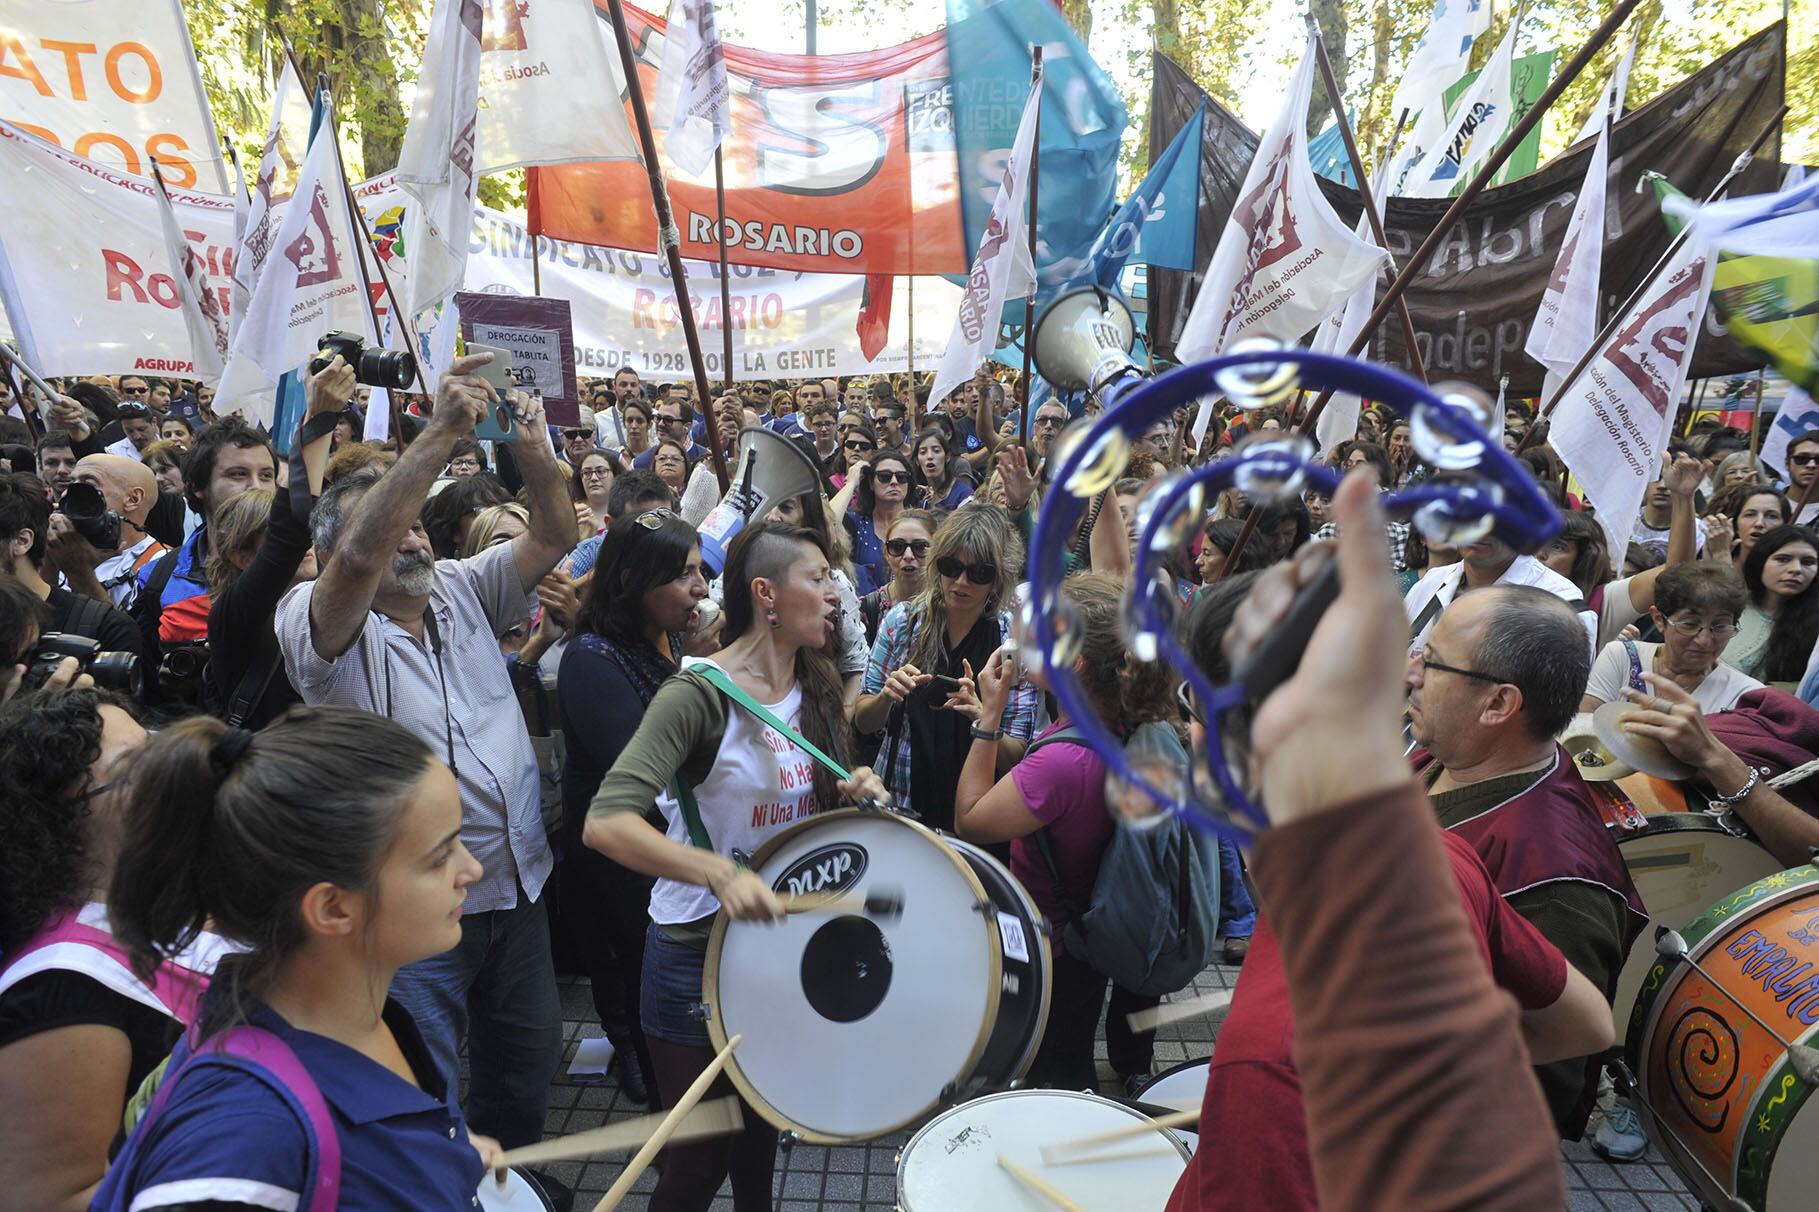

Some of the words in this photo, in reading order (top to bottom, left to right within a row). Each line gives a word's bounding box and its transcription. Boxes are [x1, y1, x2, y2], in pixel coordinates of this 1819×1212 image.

[687, 211, 864, 259] ROSARIO
[633, 287, 783, 331] ROSARIO
[487, 330, 546, 345] DEROGACIÓN
[513, 350, 549, 361] TABLITA
[574, 346, 631, 369] DESDE
[642, 351, 685, 371] 1928
[743, 352, 767, 372] LA
[777, 348, 836, 370] GENTE
[1585, 391, 1621, 441] Delegación
[1617, 440, 1645, 477] Rosario
[1604, 387, 1621, 407] del
[1616, 402, 1652, 456] Magisterio
[764, 730, 786, 753] Sin
[780, 766, 795, 791] No
[752, 803, 768, 828] Ni
[770, 801, 793, 826] Una
[787, 851, 852, 901] MXP
